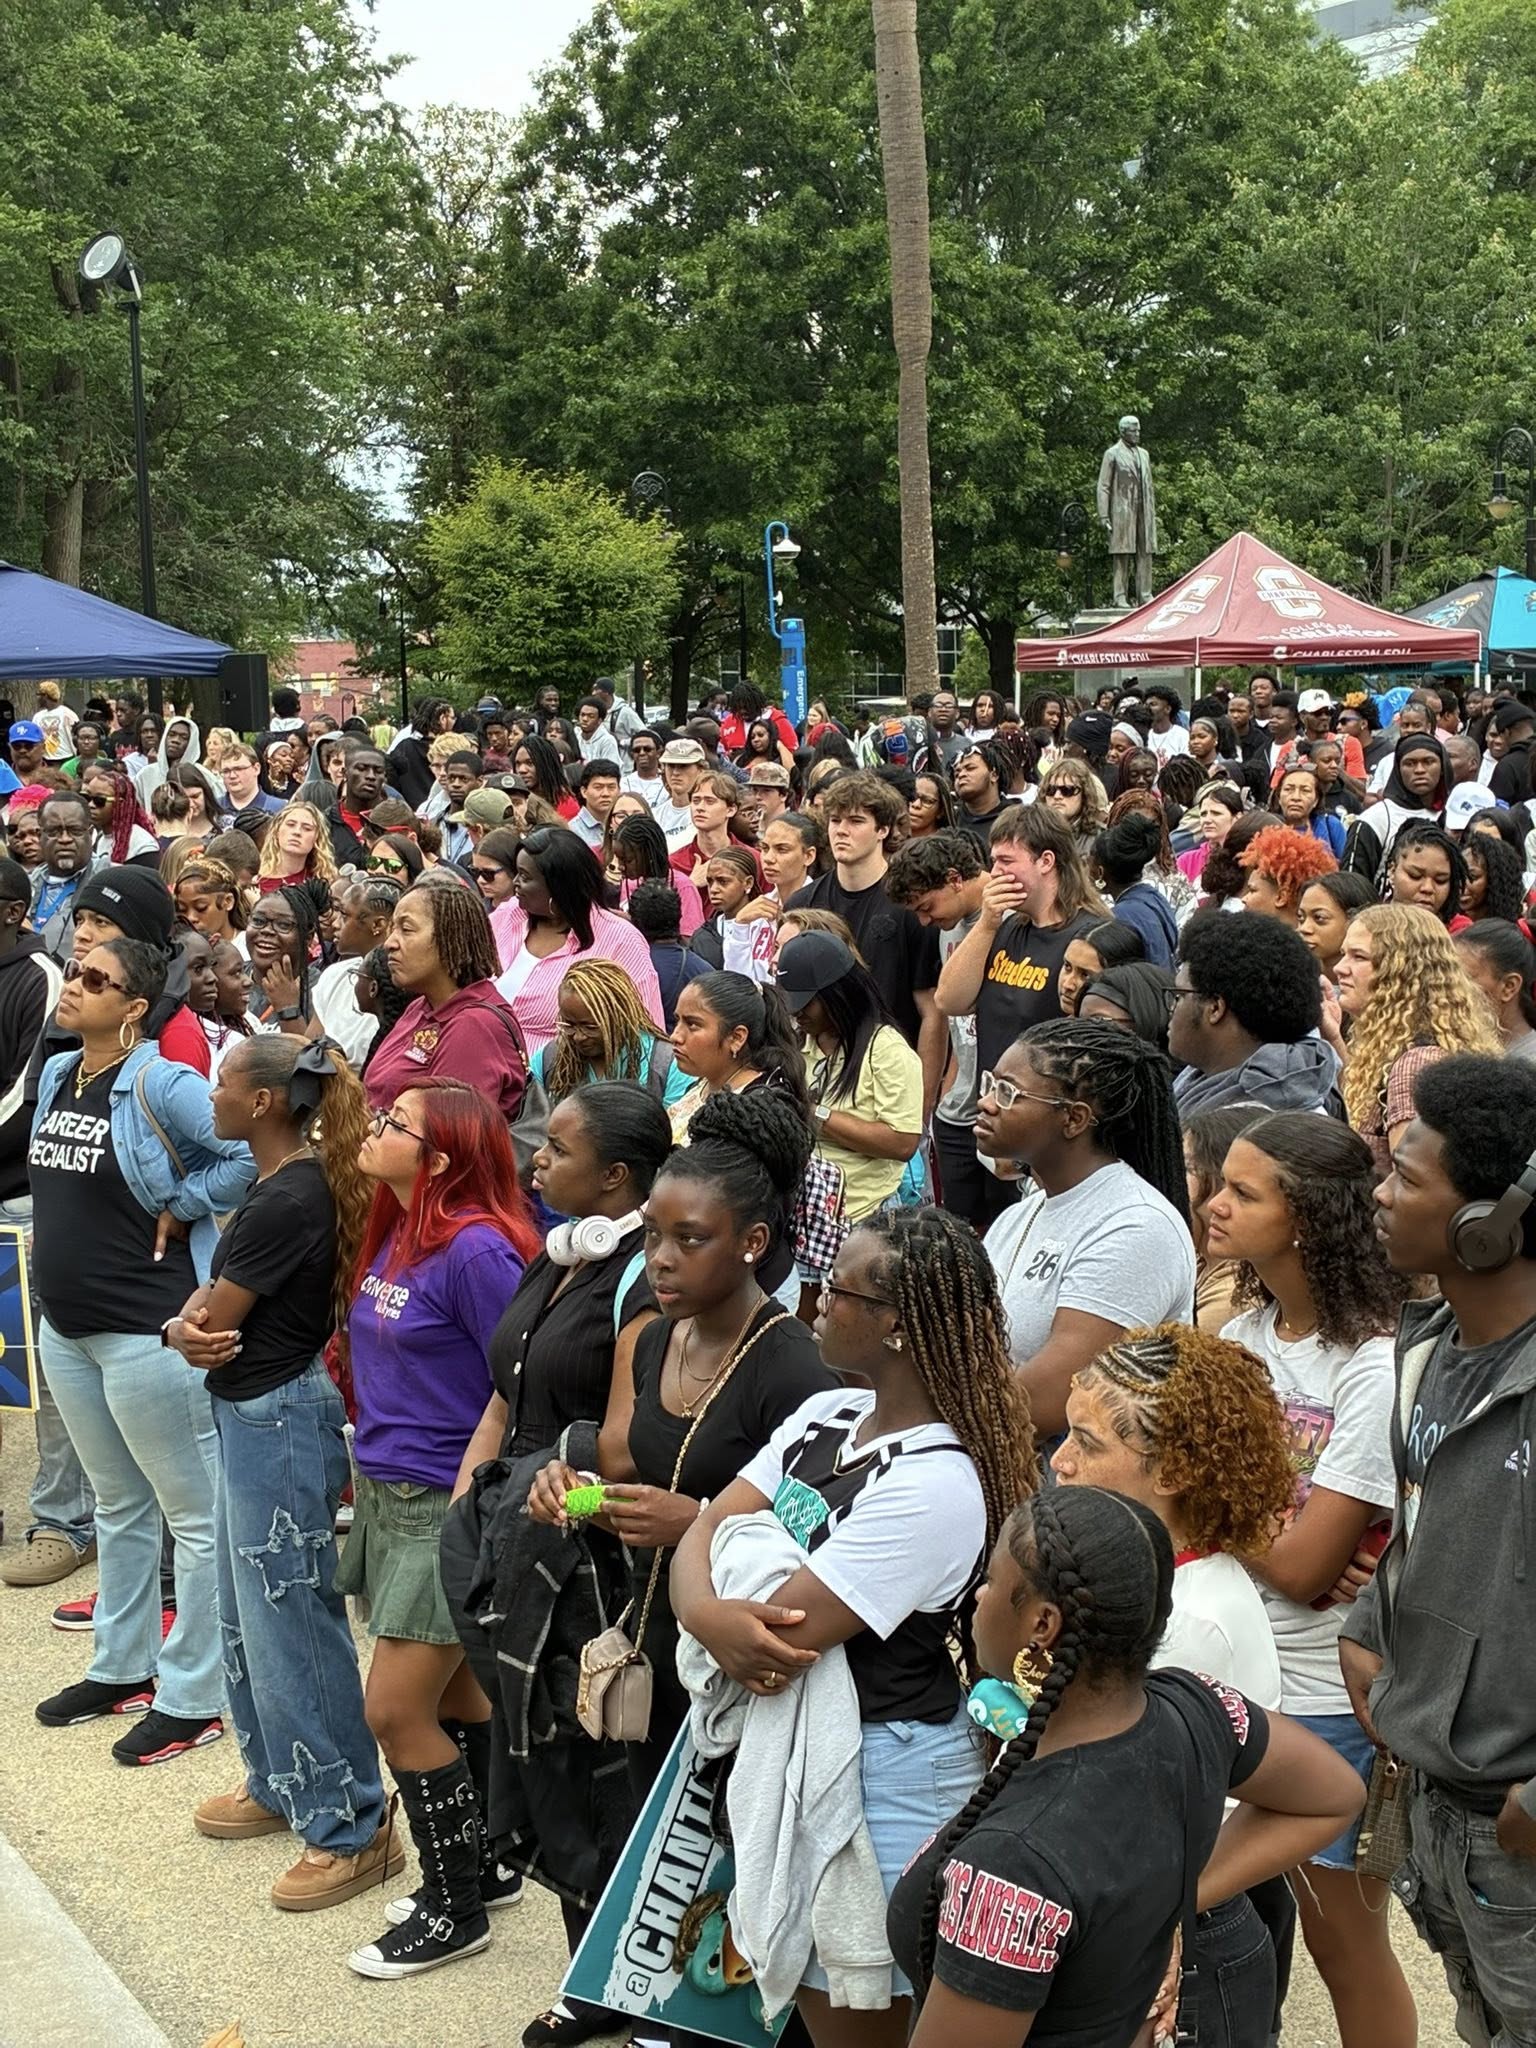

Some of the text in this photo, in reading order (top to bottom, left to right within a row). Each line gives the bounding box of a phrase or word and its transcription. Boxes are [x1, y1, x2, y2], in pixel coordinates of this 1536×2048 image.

[795, 670, 806, 723] Emergenc
[988, 950, 1050, 991] Steelers
[1022, 1249, 1062, 1281] 26
[956, 1869, 1073, 1973] ANGELES
